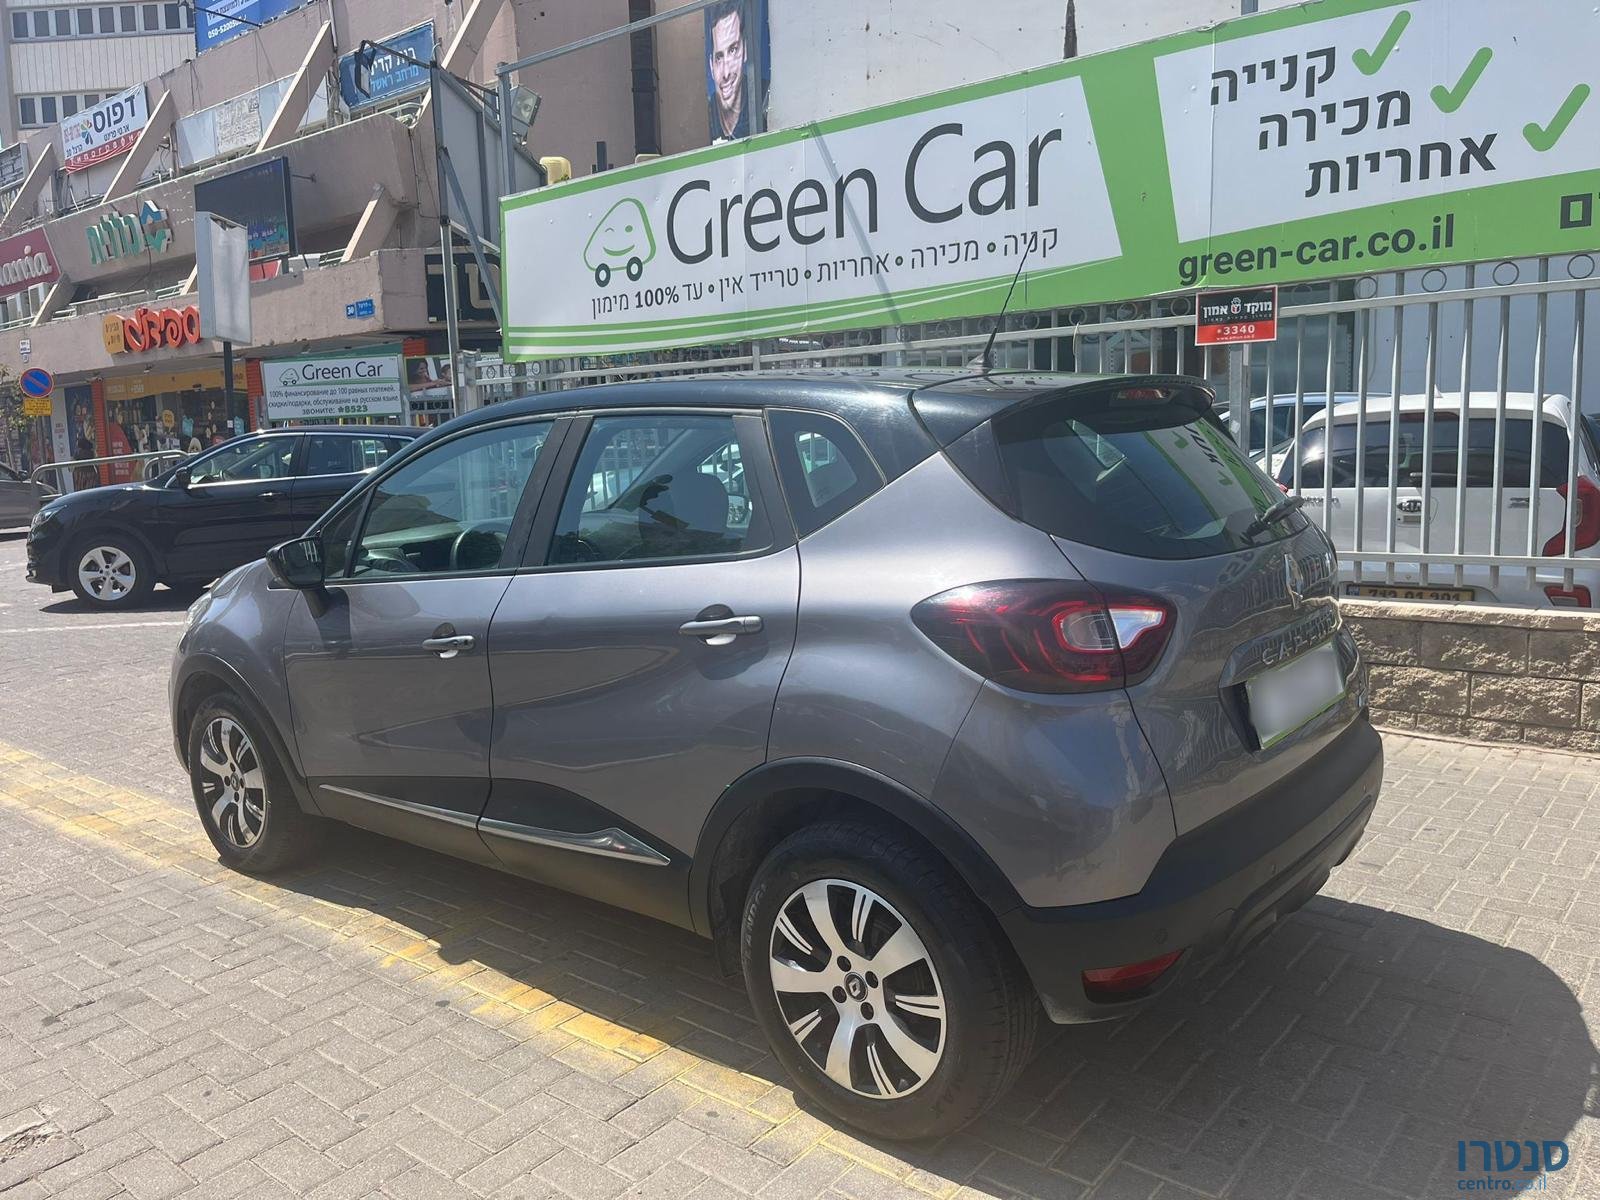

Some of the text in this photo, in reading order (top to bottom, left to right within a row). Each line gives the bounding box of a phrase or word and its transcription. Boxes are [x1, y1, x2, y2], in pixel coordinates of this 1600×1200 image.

[370, 55, 393, 76] קדי
[1211, 46, 1337, 106] קנייה
[92, 94, 136, 134] דפוס
[1258, 90, 1411, 151] מכירה
[1304, 133, 1498, 198] אחריות
[666, 121, 1063, 265] Green Car
[0, 245, 51, 287] ania
[591, 226, 1058, 321] קניה מכירה אחריות טרייד אין עד 100% מימון
[1178, 214, 1455, 286] green-car.co.il
[1203, 305, 1229, 319] אמון
[1244, 301, 1273, 315] מוקד
[302, 361, 383, 380] Green Car
